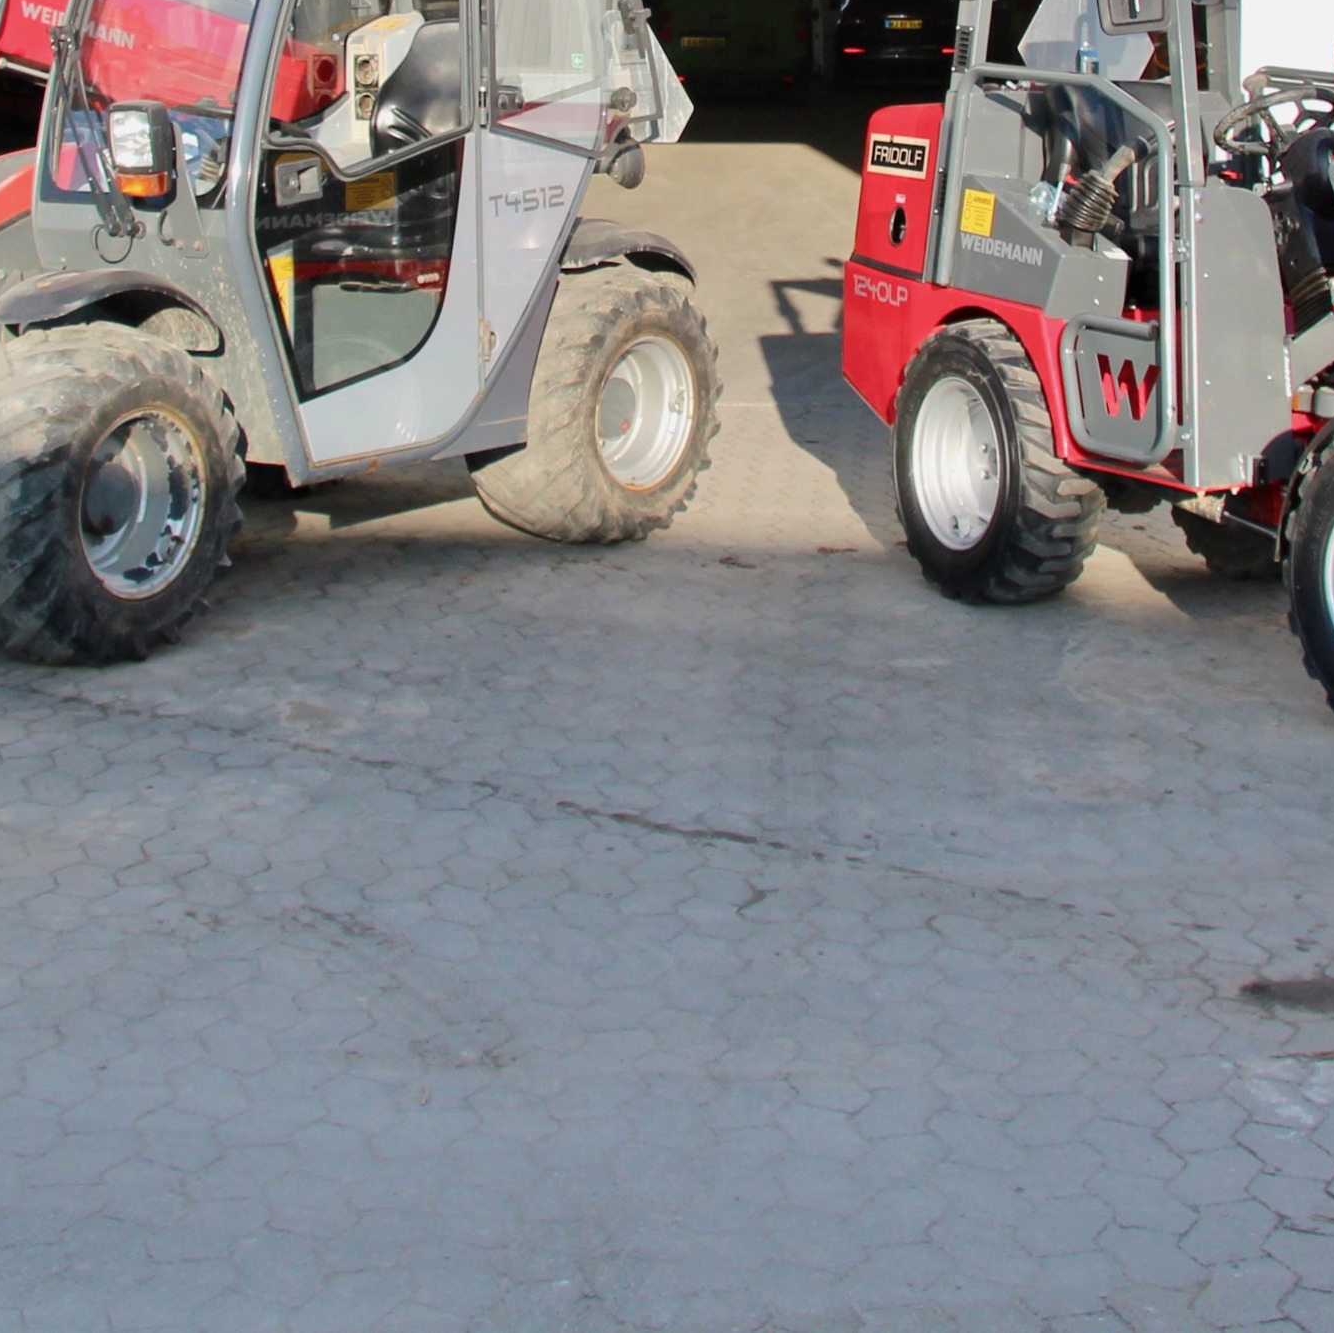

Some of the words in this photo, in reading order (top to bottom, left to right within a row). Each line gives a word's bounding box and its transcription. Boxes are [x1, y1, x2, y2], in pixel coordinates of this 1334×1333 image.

[873, 145, 924, 167] FRIDOLF
[488, 184, 565, 218] T4512
[960, 231, 1044, 267] WEIDEMANN
